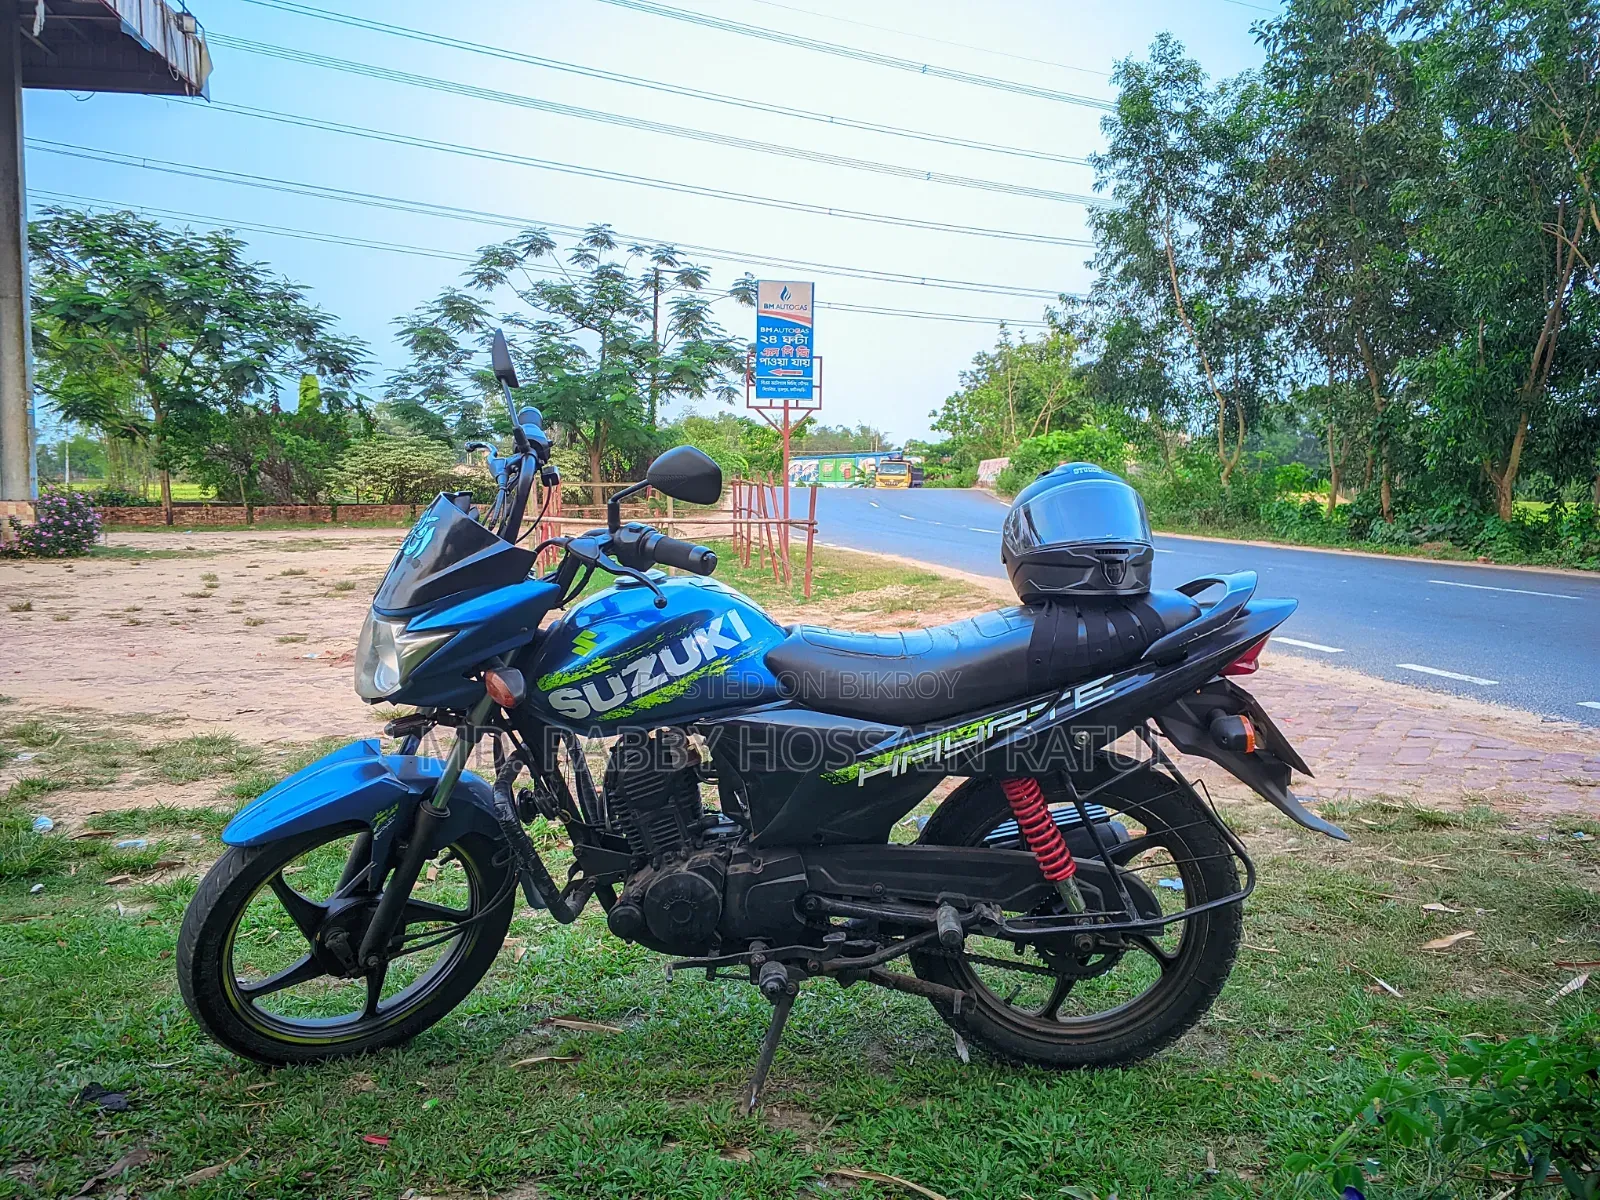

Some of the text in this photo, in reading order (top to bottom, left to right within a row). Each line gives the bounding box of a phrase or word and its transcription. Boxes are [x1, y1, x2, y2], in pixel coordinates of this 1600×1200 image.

[760, 335, 778, 344] ২৪
[781, 345, 794, 357] পি
[759, 358, 811, 367] পাওয়া যায়
[548, 609, 752, 720] SUZUKI
[857, 674, 1114, 787] HAYATE
